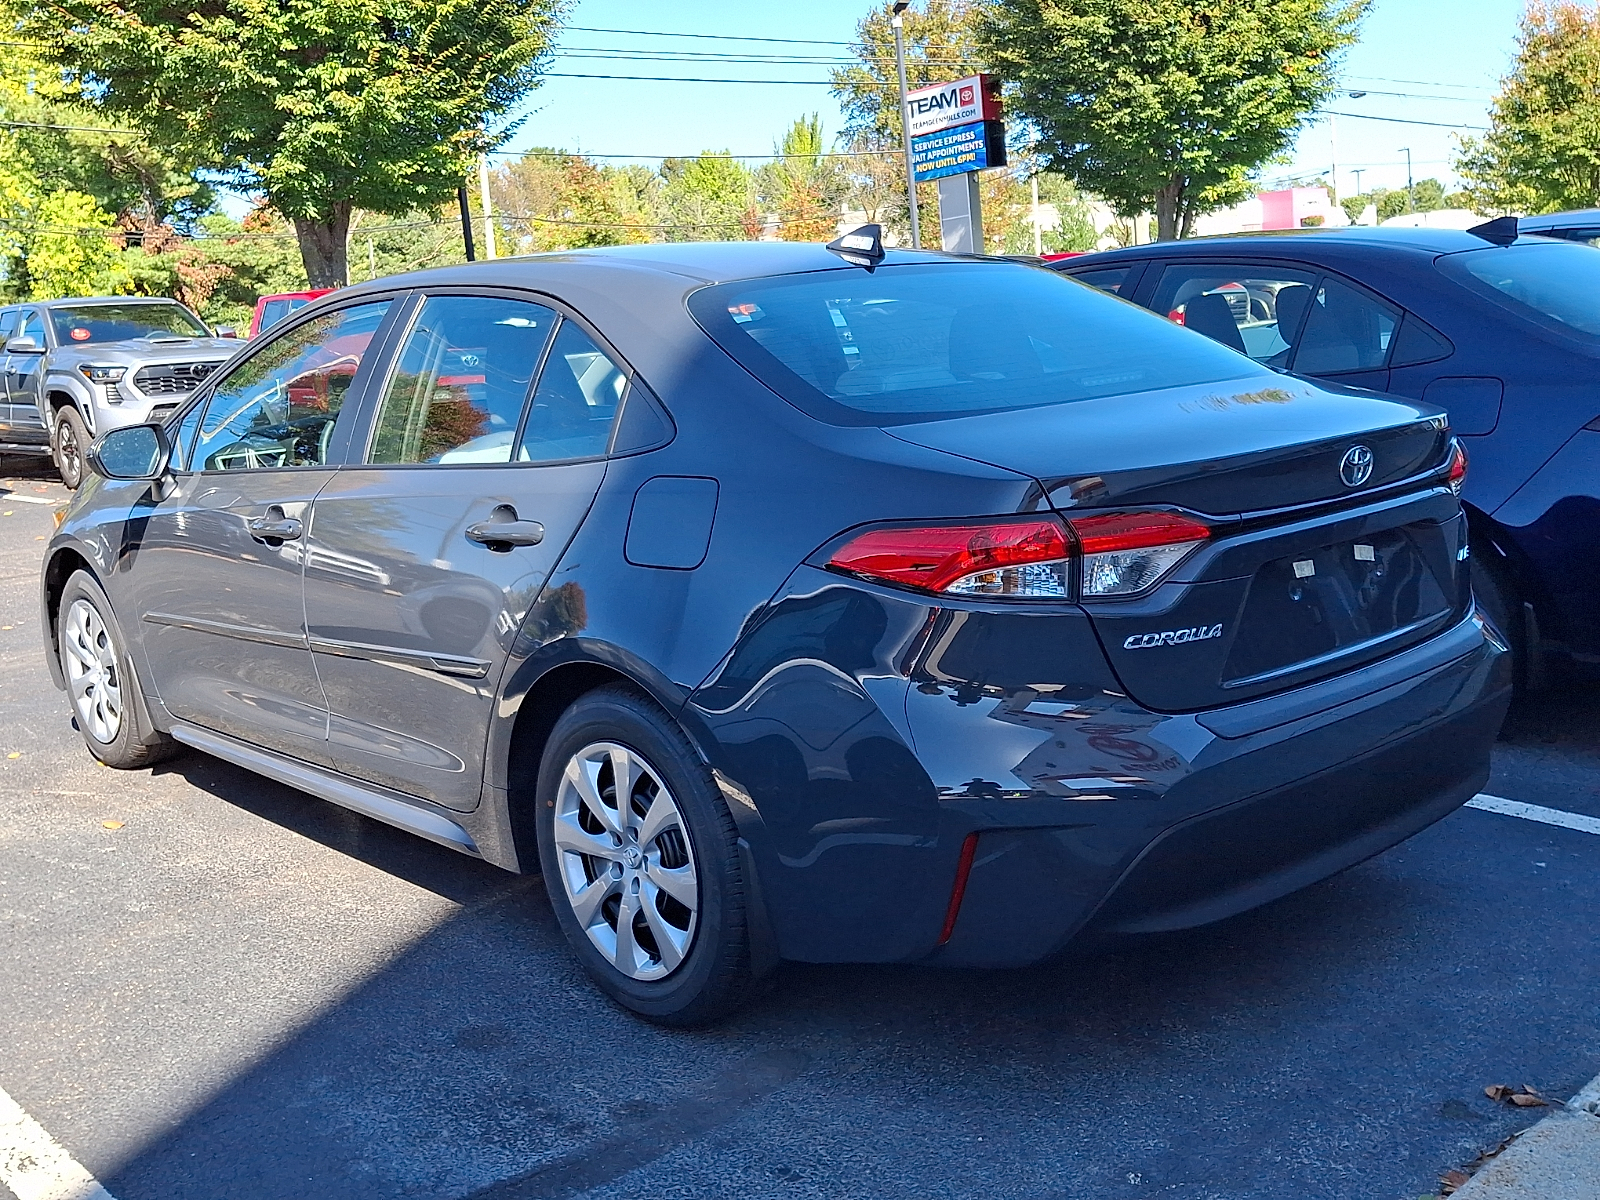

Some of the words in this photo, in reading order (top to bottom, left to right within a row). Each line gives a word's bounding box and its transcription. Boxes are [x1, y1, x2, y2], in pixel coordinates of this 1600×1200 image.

[908, 88, 958, 118] TEAM
[913, 109, 976, 130] TEAMGLENMILLS.COM
[914, 138, 943, 152] SERVICE
[944, 131, 975, 145] EXPRESS
[927, 140, 983, 160] APPOINTMENTS
[916, 161, 935, 172] NOW
[936, 156, 957, 168] UNTIL
[957, 152, 975, 164] 6PM!
[1123, 623, 1222, 649] COROLLA
